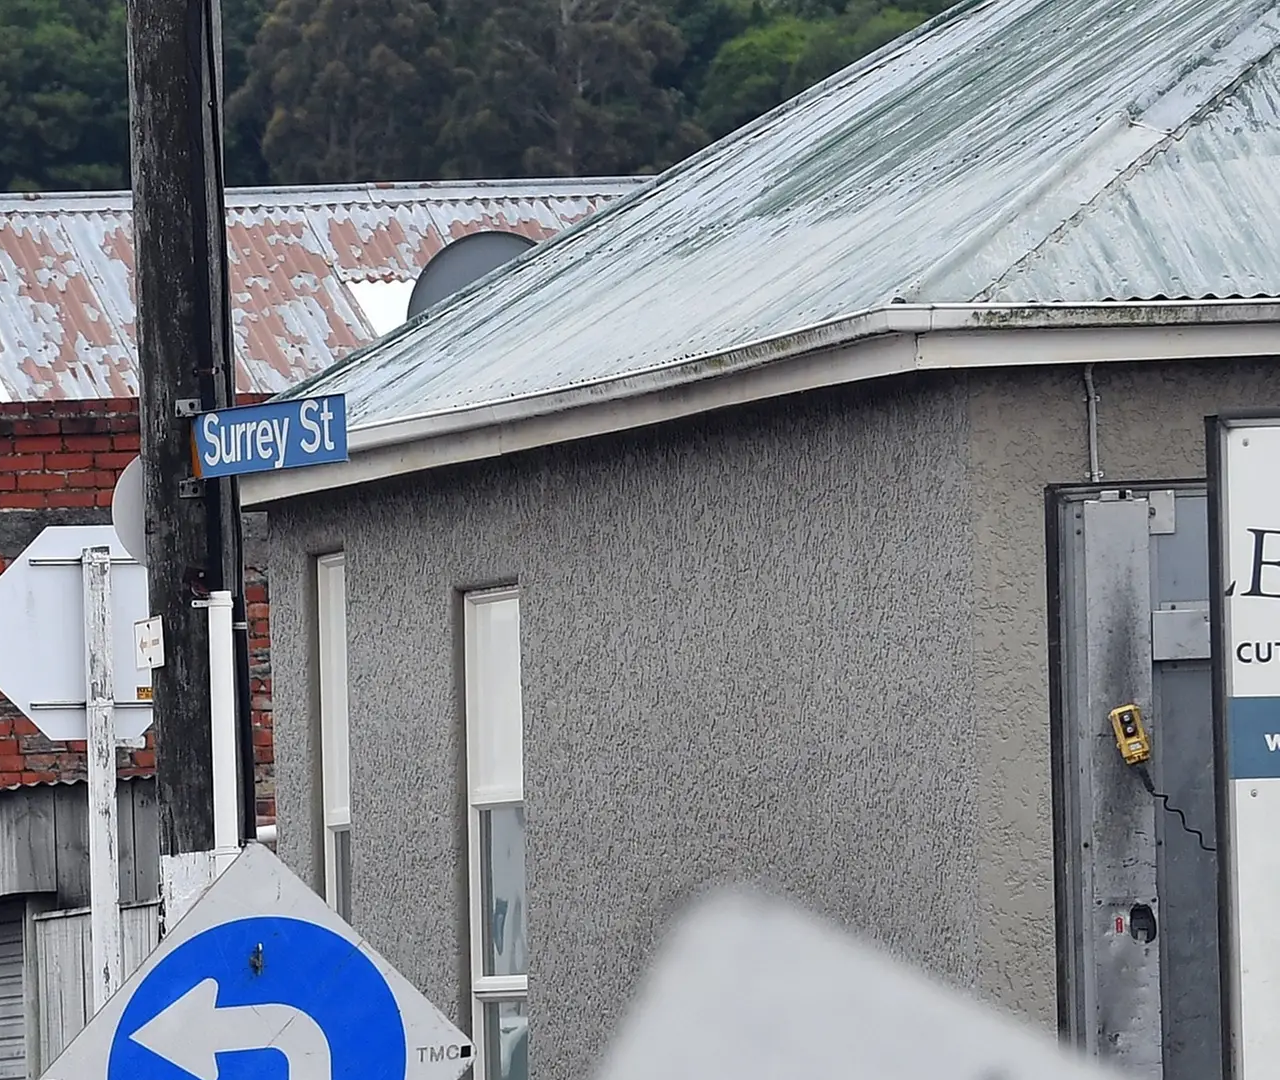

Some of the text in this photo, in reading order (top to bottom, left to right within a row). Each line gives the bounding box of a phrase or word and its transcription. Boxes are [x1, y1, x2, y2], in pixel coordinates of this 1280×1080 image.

[203, 398, 335, 468] Surrey St
[1236, 642, 1280, 664] CU
[416, 1044, 460, 1062] TMC
